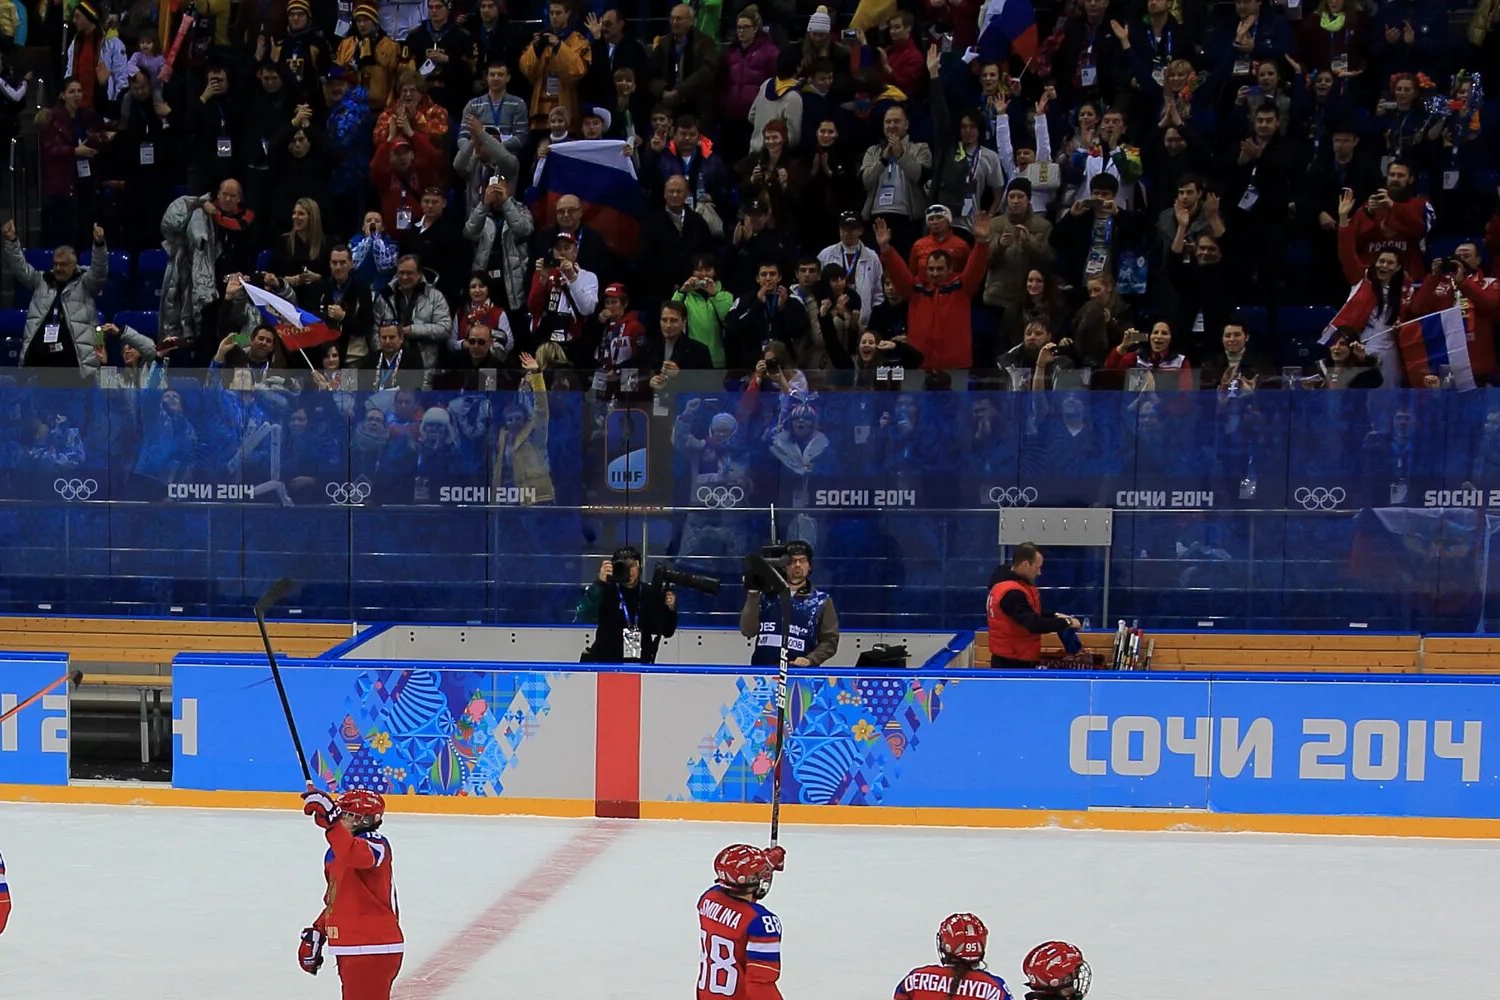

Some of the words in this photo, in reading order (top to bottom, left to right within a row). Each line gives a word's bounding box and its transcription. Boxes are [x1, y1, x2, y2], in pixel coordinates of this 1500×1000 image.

[167, 483, 212, 498] СОЧИ
[216, 484, 254, 499] 2014
[440, 486, 491, 502] SOCHI
[495, 487, 536, 503] 2014
[815, 490, 868, 505] SOCHI
[873, 490, 916, 505] 2014
[1116, 491, 1166, 506] СОЧИ
[1171, 491, 1214, 507] 2014
[1424, 490, 1483, 506] SOCHI
[1070, 715, 1274, 779] СОЧИ
[1299, 718, 1482, 782] 2014
[700, 899, 742, 930] SMOLINA
[965, 943, 977, 951] 95
